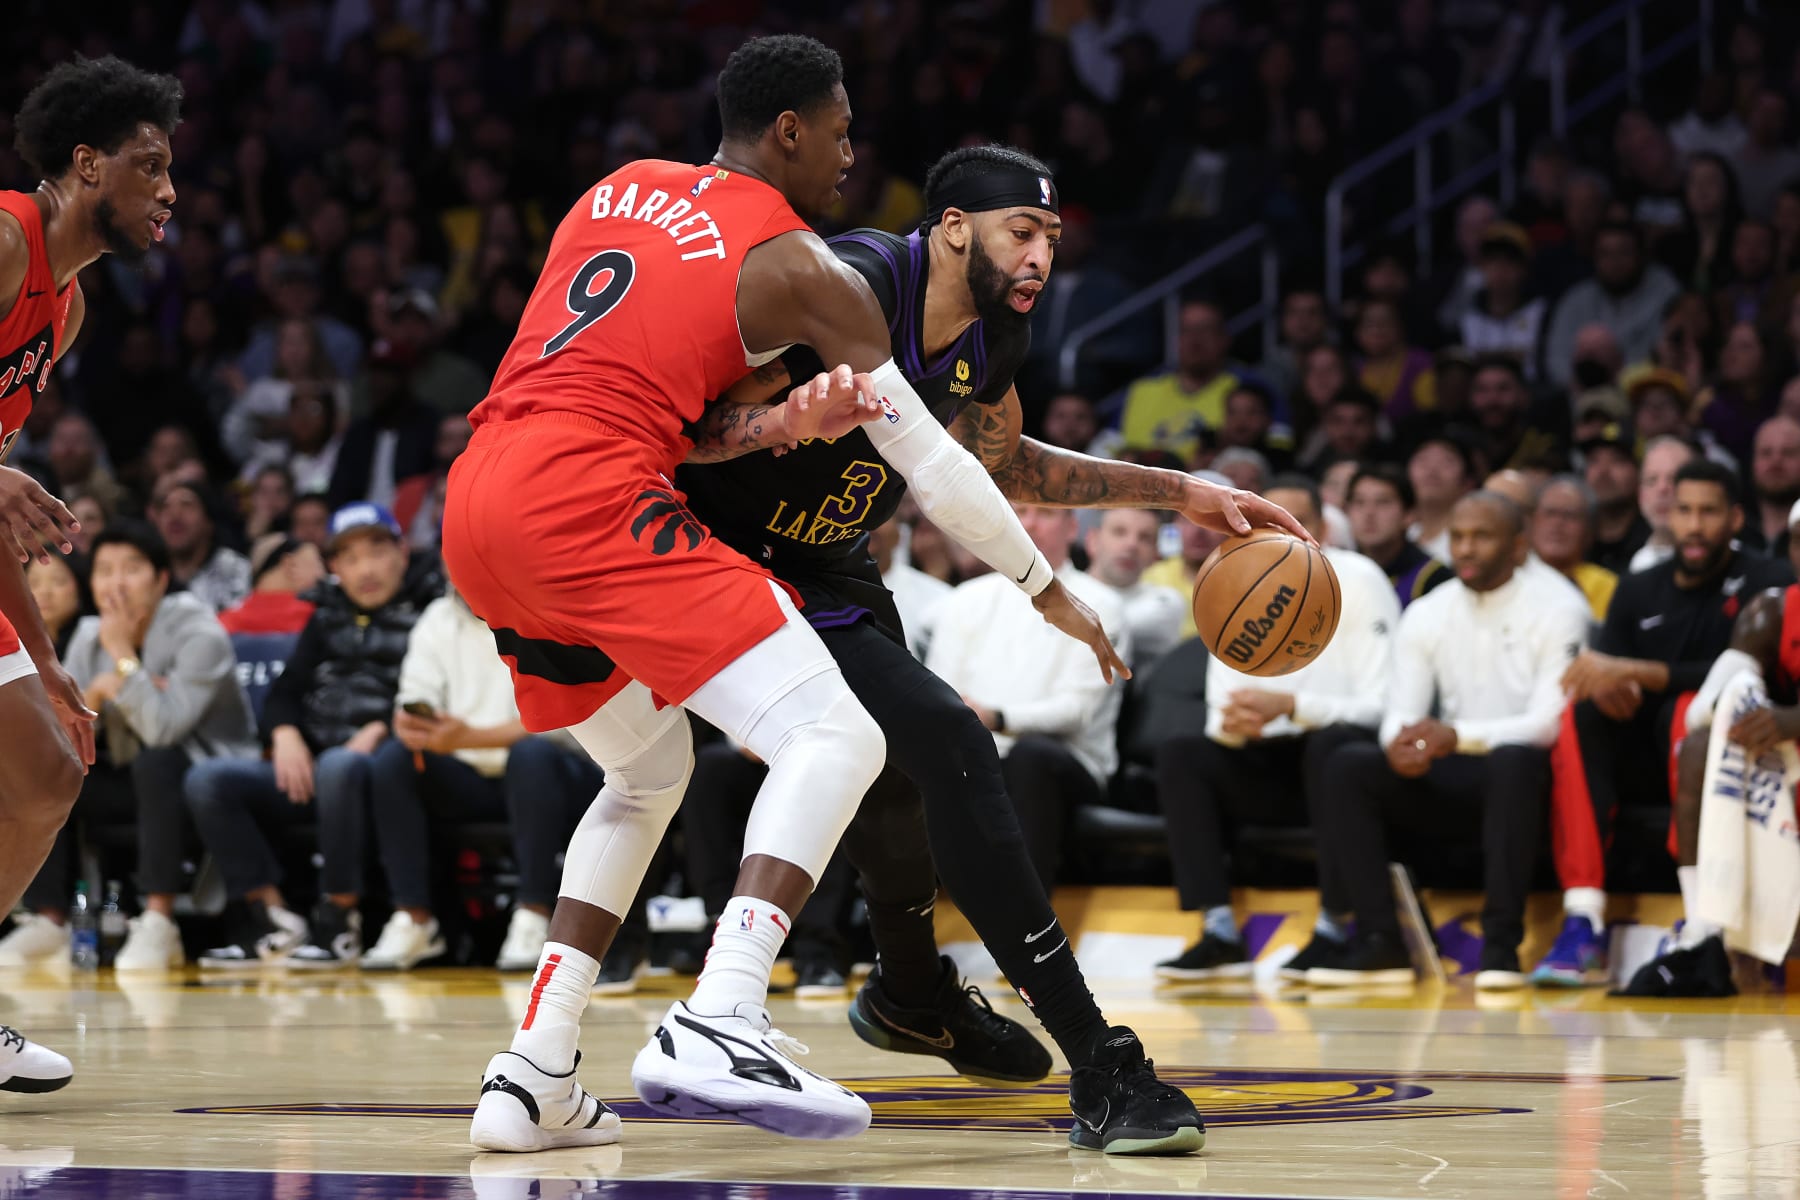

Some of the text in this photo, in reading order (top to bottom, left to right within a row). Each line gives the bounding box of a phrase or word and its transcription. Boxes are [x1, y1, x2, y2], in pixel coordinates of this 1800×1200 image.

[591, 182, 726, 261] BARRETT
[538, 249, 636, 359] 9
[949, 380, 973, 398] bibigo
[815, 460, 888, 528] 3
[1224, 584, 1297, 664] Wilson
